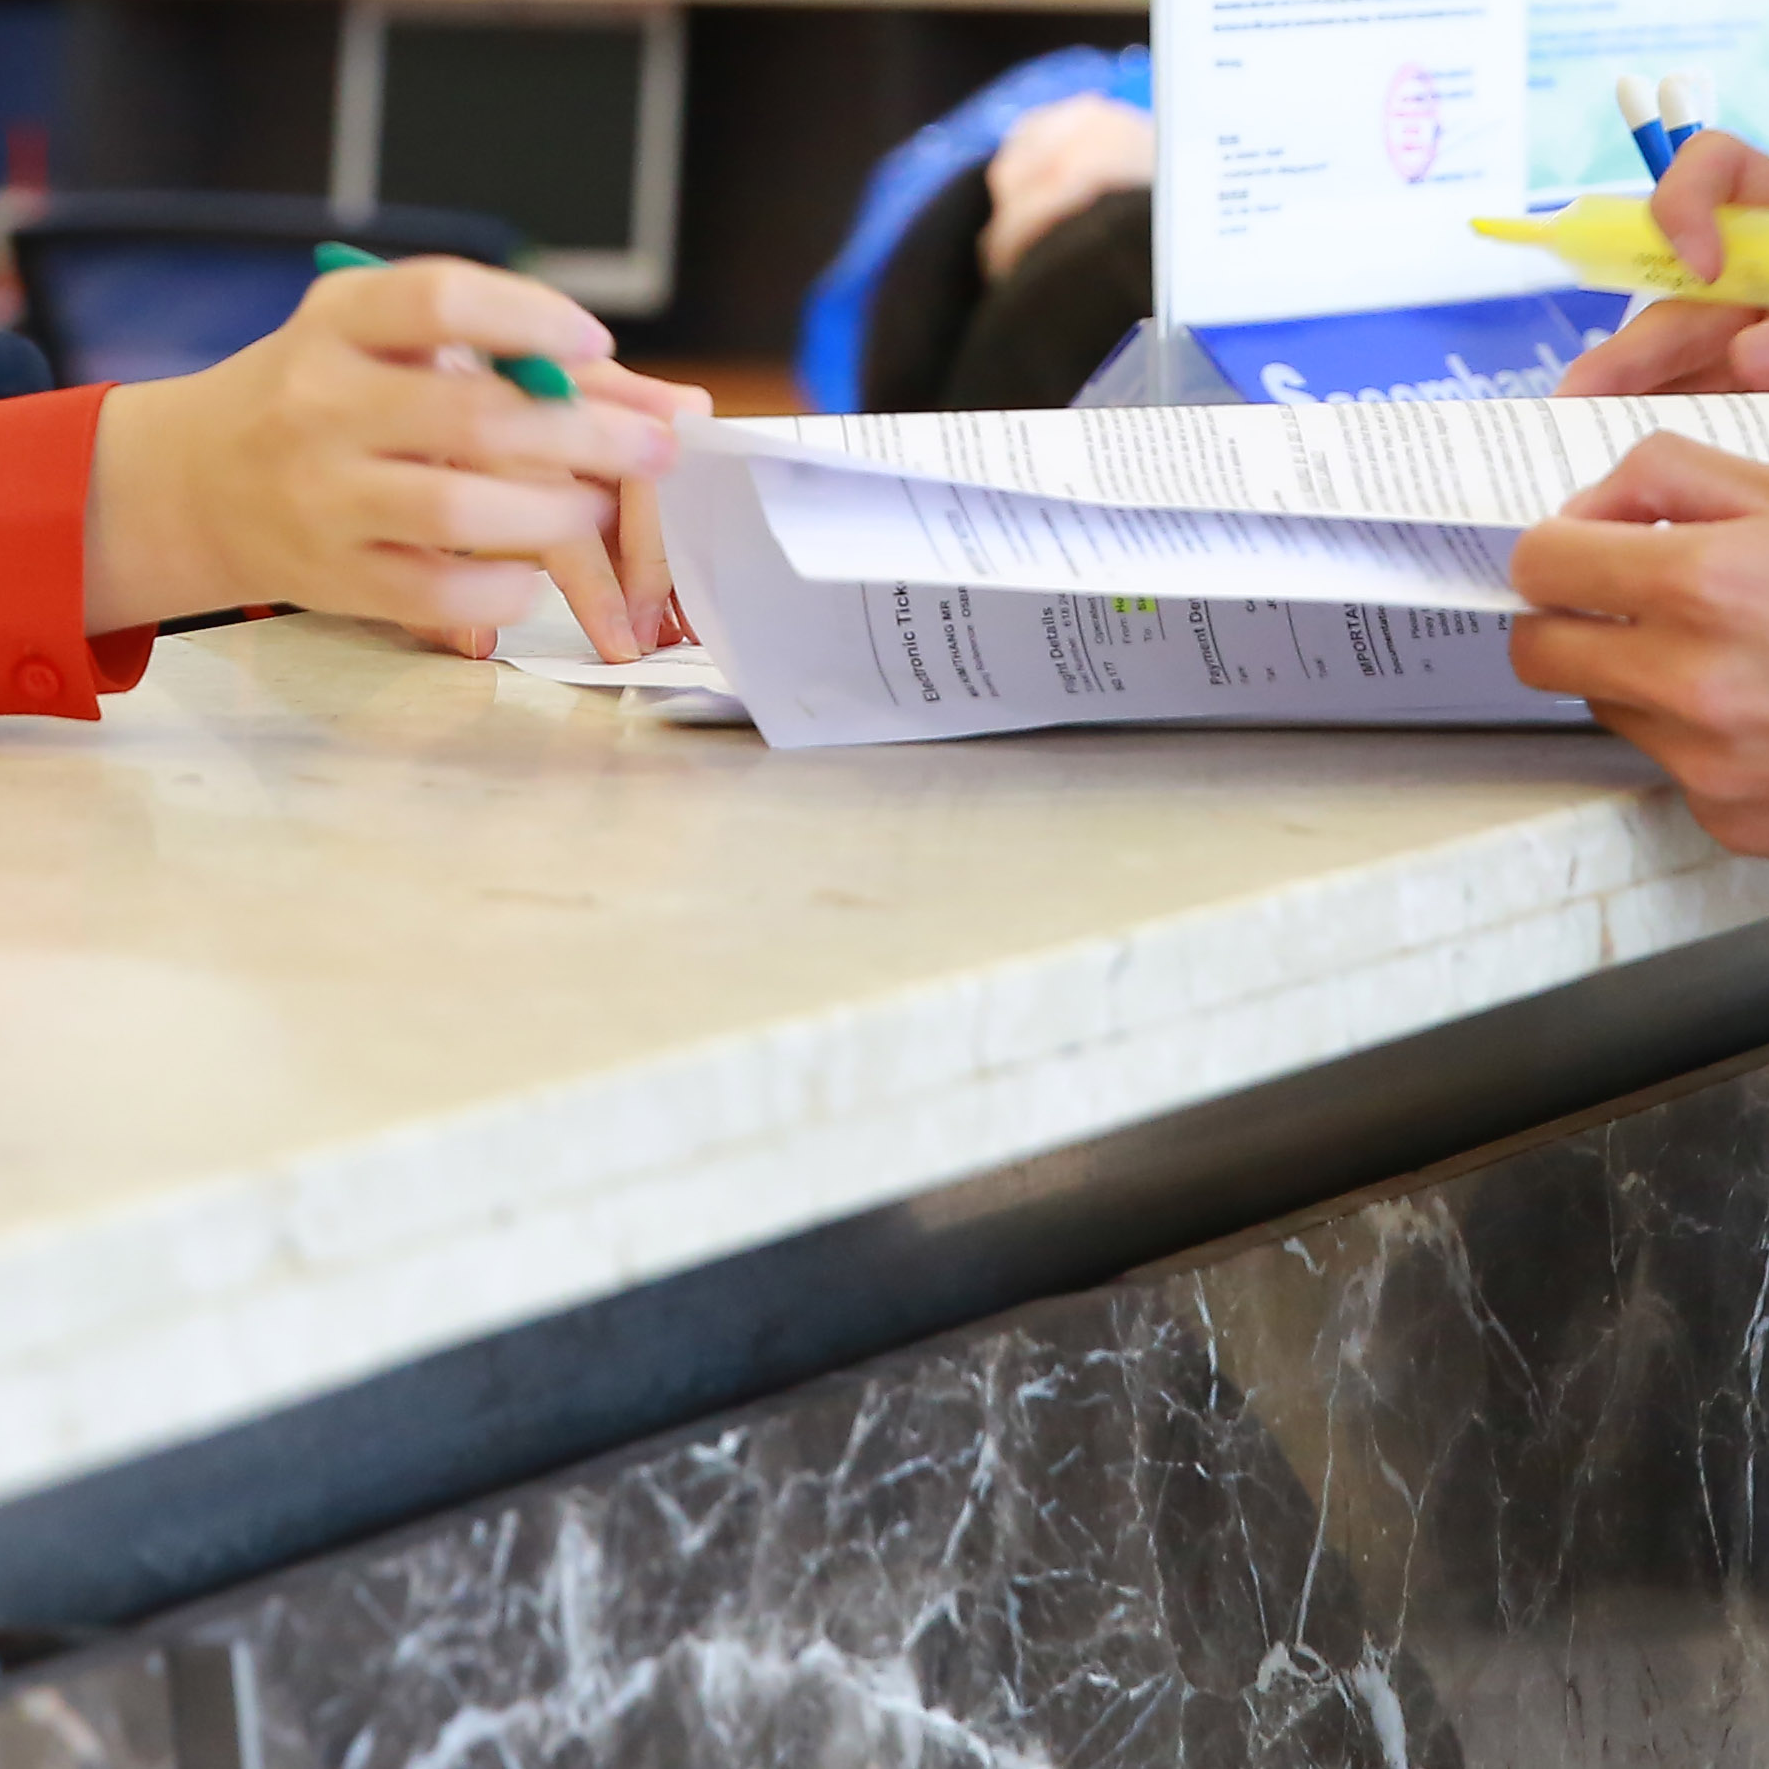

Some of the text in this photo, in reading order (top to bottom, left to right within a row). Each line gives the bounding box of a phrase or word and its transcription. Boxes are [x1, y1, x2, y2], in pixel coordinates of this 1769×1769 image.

[892, 581, 941, 702] Electronic Tick
[1041, 607, 1064, 658] Details
[1409, 607, 1420, 639] Pleas
[1194, 628, 1223, 685] Payment
